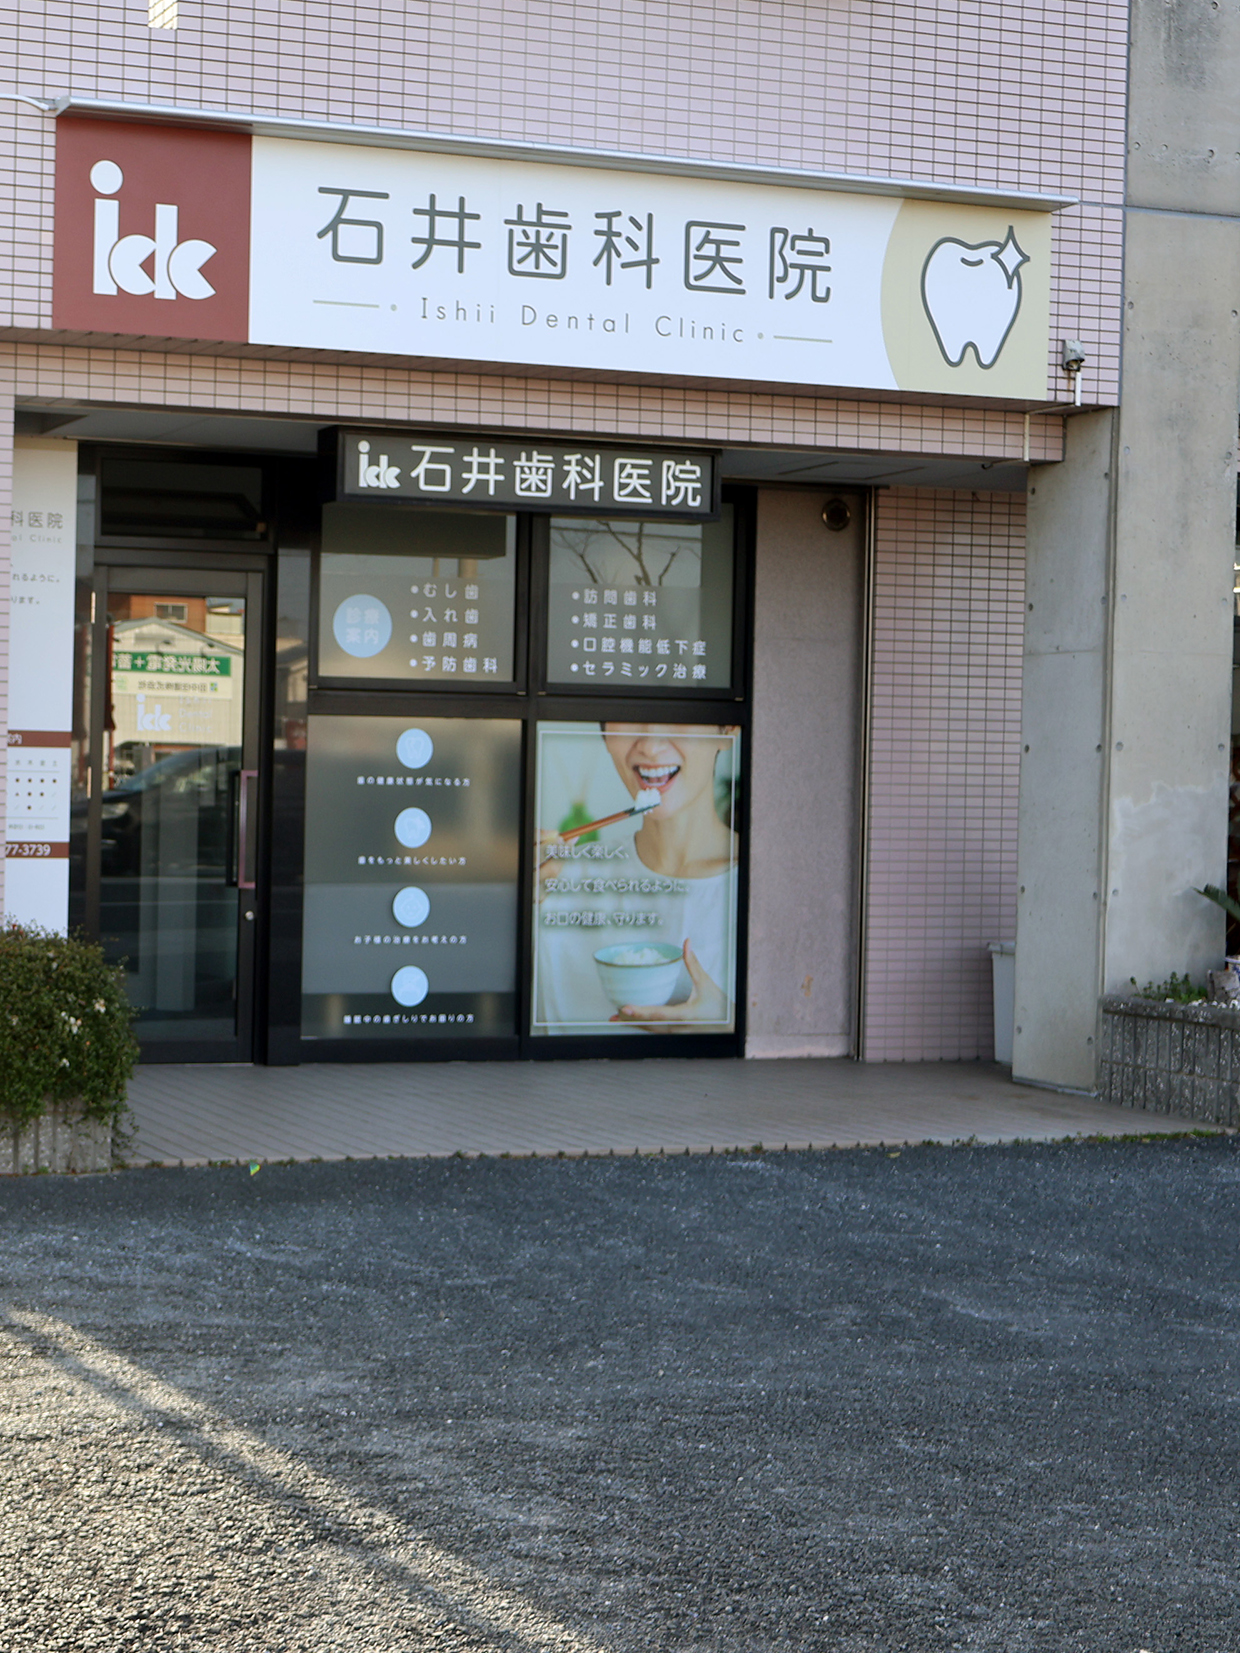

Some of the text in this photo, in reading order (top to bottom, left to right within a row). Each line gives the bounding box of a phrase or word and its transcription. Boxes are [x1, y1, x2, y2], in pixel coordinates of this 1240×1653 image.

[316, 186, 832, 303] 石井歯科医院
[422, 297, 743, 342] Ishii Dental Clinic
[411, 445, 702, 507] 石井歯科医院
[423, 582, 479, 600] むし歯
[584, 588, 657, 606] 訪問歯科
[346, 607, 380, 624] 診療
[422, 607, 479, 624] 入れ歯
[583, 612, 657, 630] 矯正歯科
[346, 627, 380, 644] 案内
[422, 631, 478, 649] 歯周病
[583, 637, 707, 656] 口腔機能低下症
[422, 655, 498, 674] 予防歯科
[582, 660, 707, 680] セラミック治療
